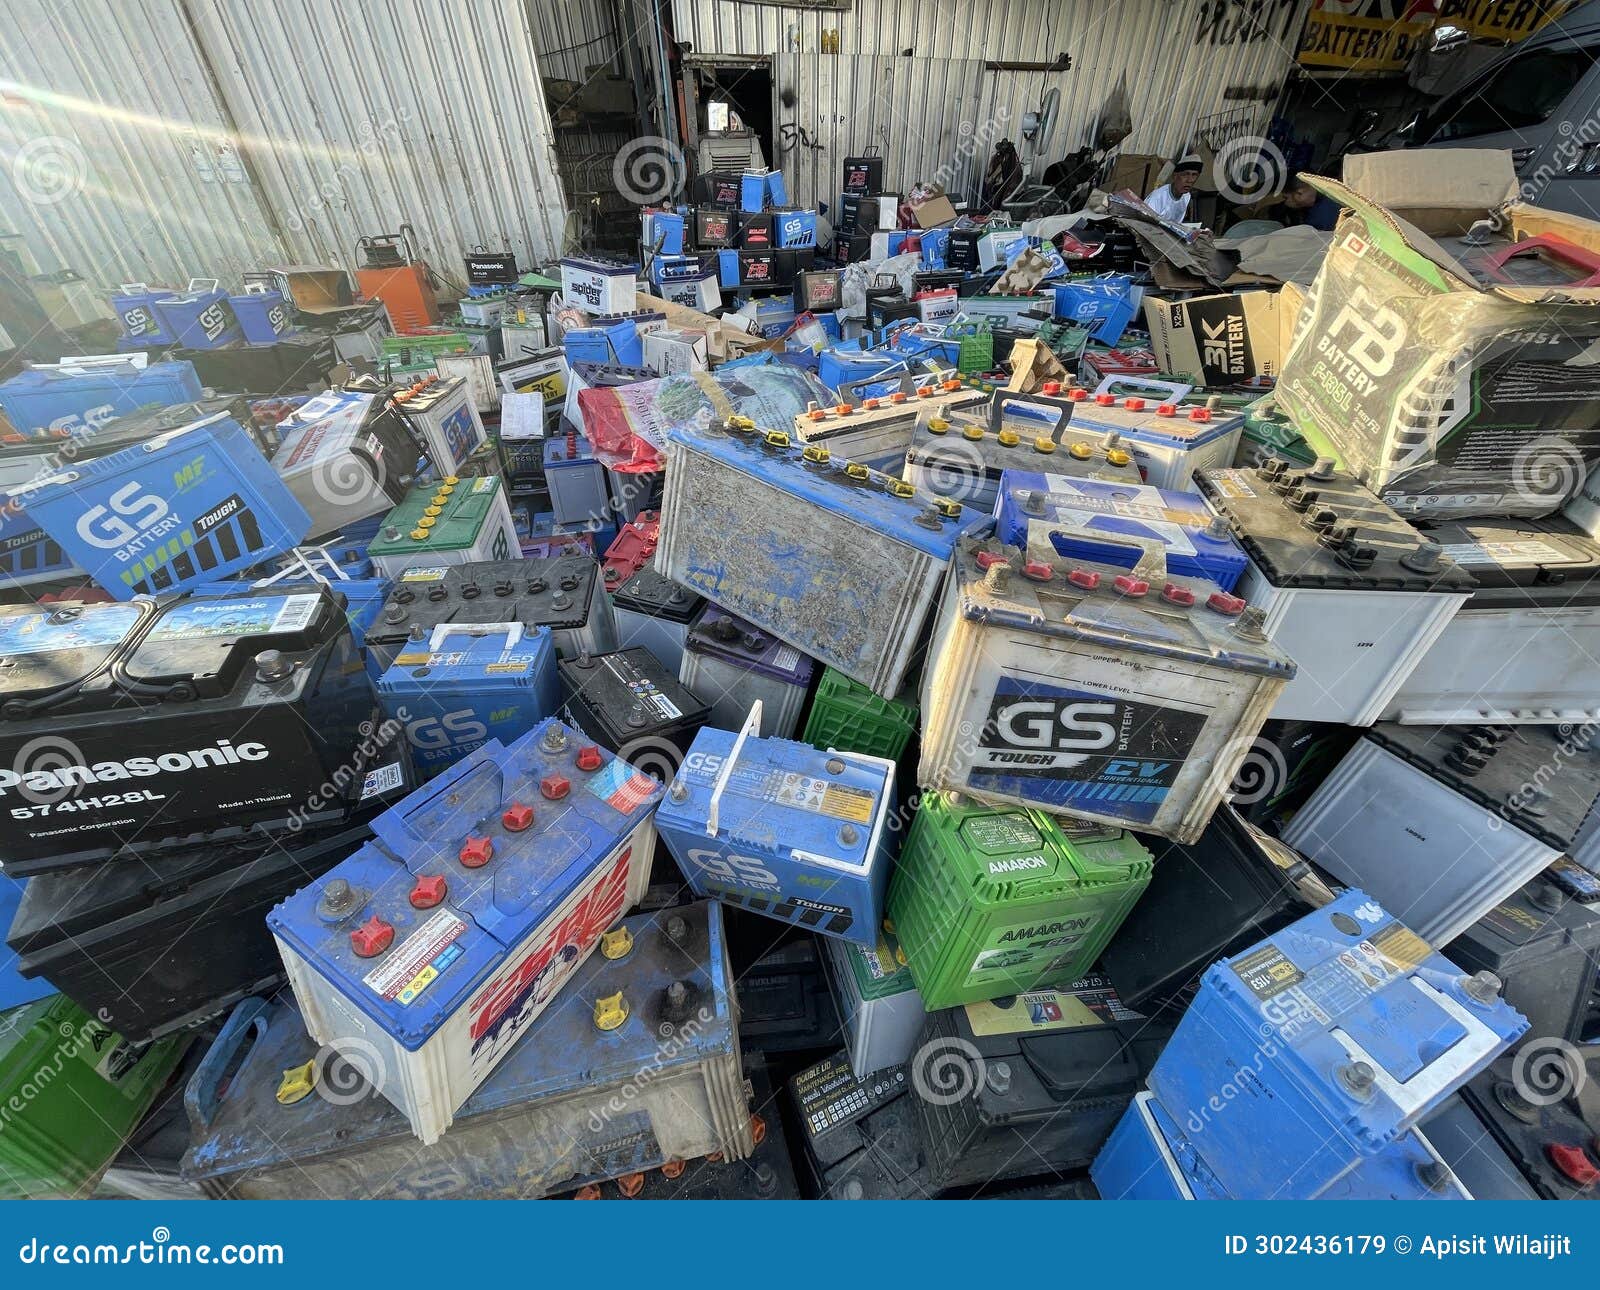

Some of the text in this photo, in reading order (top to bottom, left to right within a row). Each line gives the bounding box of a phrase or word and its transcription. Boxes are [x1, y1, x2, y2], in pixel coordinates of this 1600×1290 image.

[785, 219, 801, 232] GS
[471, 262, 504, 270] Panasonic
[125, 308, 146, 326] GS
[200, 304, 224, 328] GS
[269, 306, 283, 323] GS
[933, 309, 954, 318] YUASA
[1078, 301, 1098, 314] GS
[1202, 317, 1229, 375] 3K
[1227, 314, 1245, 375] BATTERY
[1317, 335, 1379, 398] BATTERY
[76, 481, 169, 549] GS
[197, 499, 238, 530] TOUGH
[113, 513, 182, 563] BATTERY
[192, 602, 268, 613] Panasonic
[1092, 654, 1141, 669] UPPER LEVEL
[1082, 680, 1131, 694] LOWER LEVEL
[406, 708, 488, 749] GS
[997, 701, 1117, 750] GS
[1118, 704, 1135, 751] BATTERY
[0, 739, 270, 796] Panasonic
[686, 752, 722, 772] GS
[989, 751, 1057, 765] TOUGH
[1098, 775, 1164, 785] CONVENTIONAL
[10, 789, 166, 819] 574H28L
[218, 792, 291, 809] Made in Thailand
[29, 816, 136, 838] Panasonic Corporation
[687, 848, 779, 885] GS
[988, 855, 1047, 874] AMARON
[708, 872, 783, 893] BATTERY
[795, 898, 845, 914] TOUGH
[997, 917, 1091, 944] AMARON
[1260, 992, 1300, 1024] GS
[796, 1060, 831, 1086] DOUBLE LID
[835, 1063, 850, 1075] FREE
